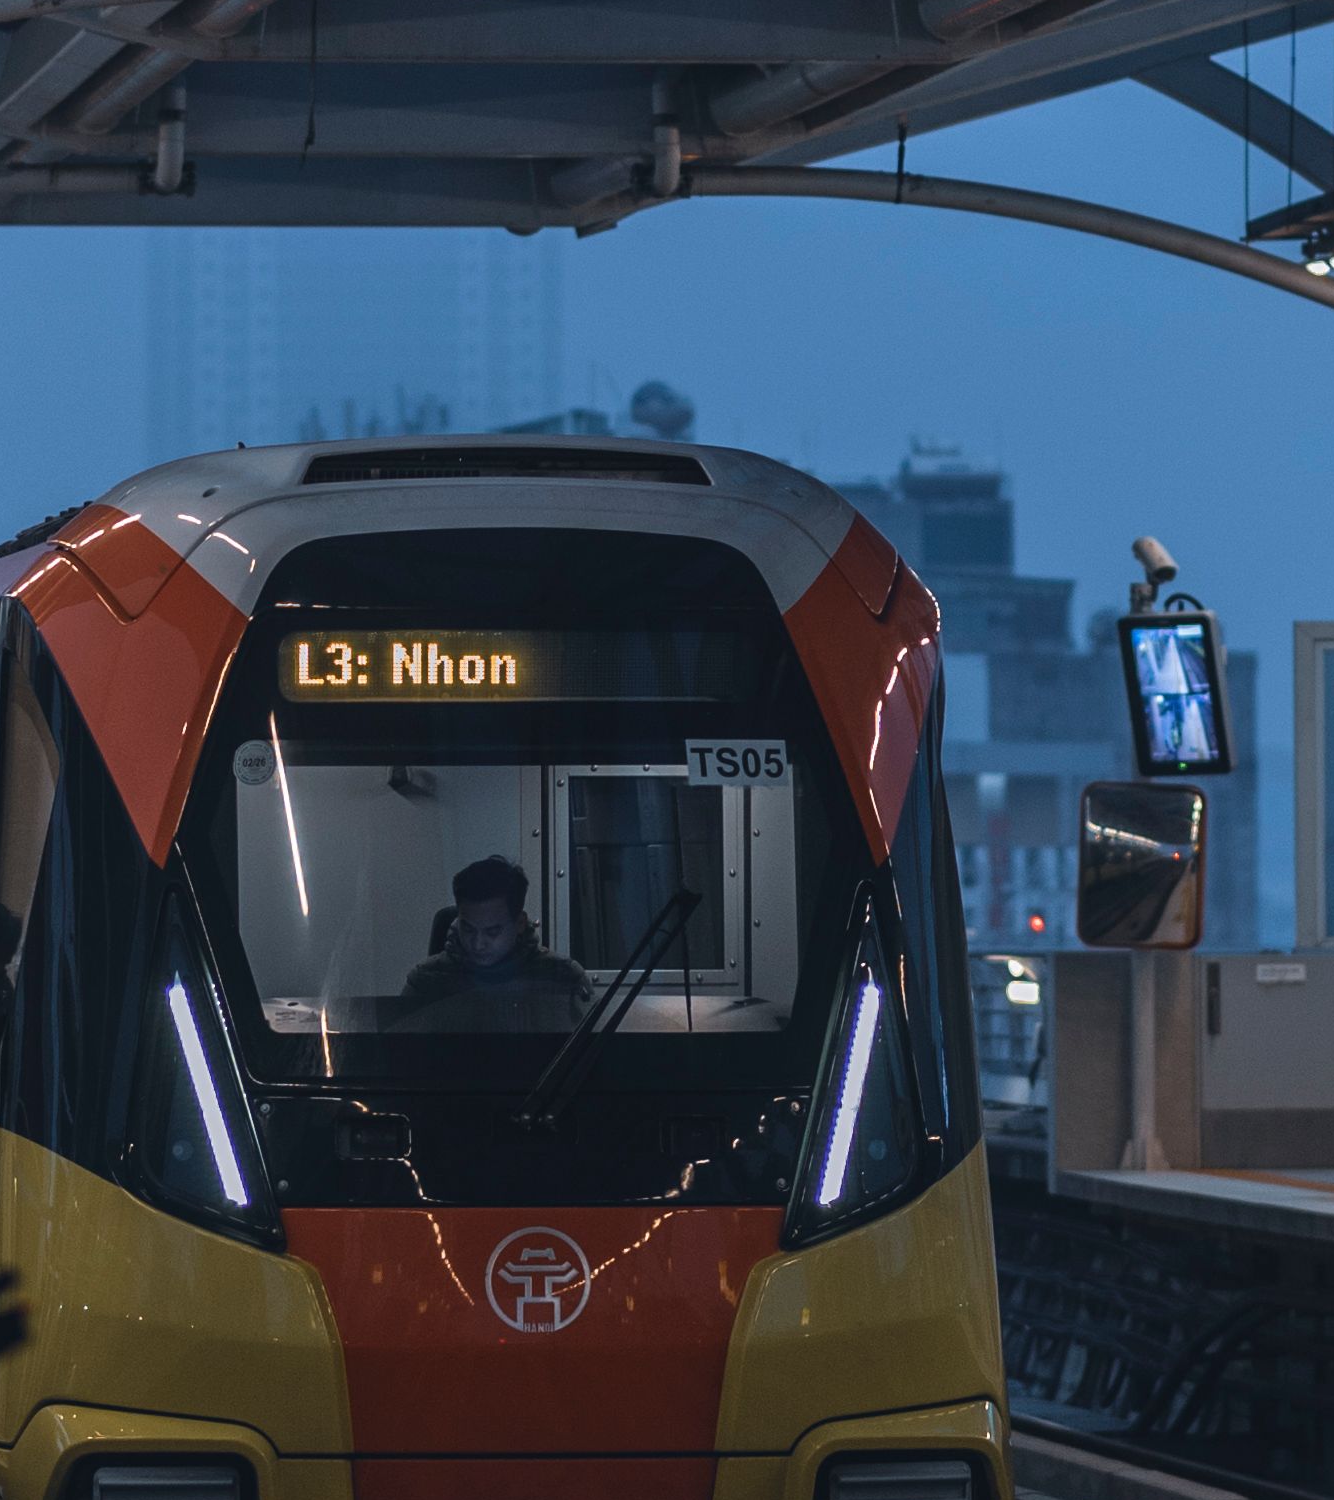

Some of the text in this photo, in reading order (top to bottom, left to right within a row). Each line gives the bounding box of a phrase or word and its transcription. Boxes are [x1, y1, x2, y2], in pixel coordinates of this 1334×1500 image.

[298, 642, 517, 685] L3: Nhon
[690, 747, 784, 778] TS05
